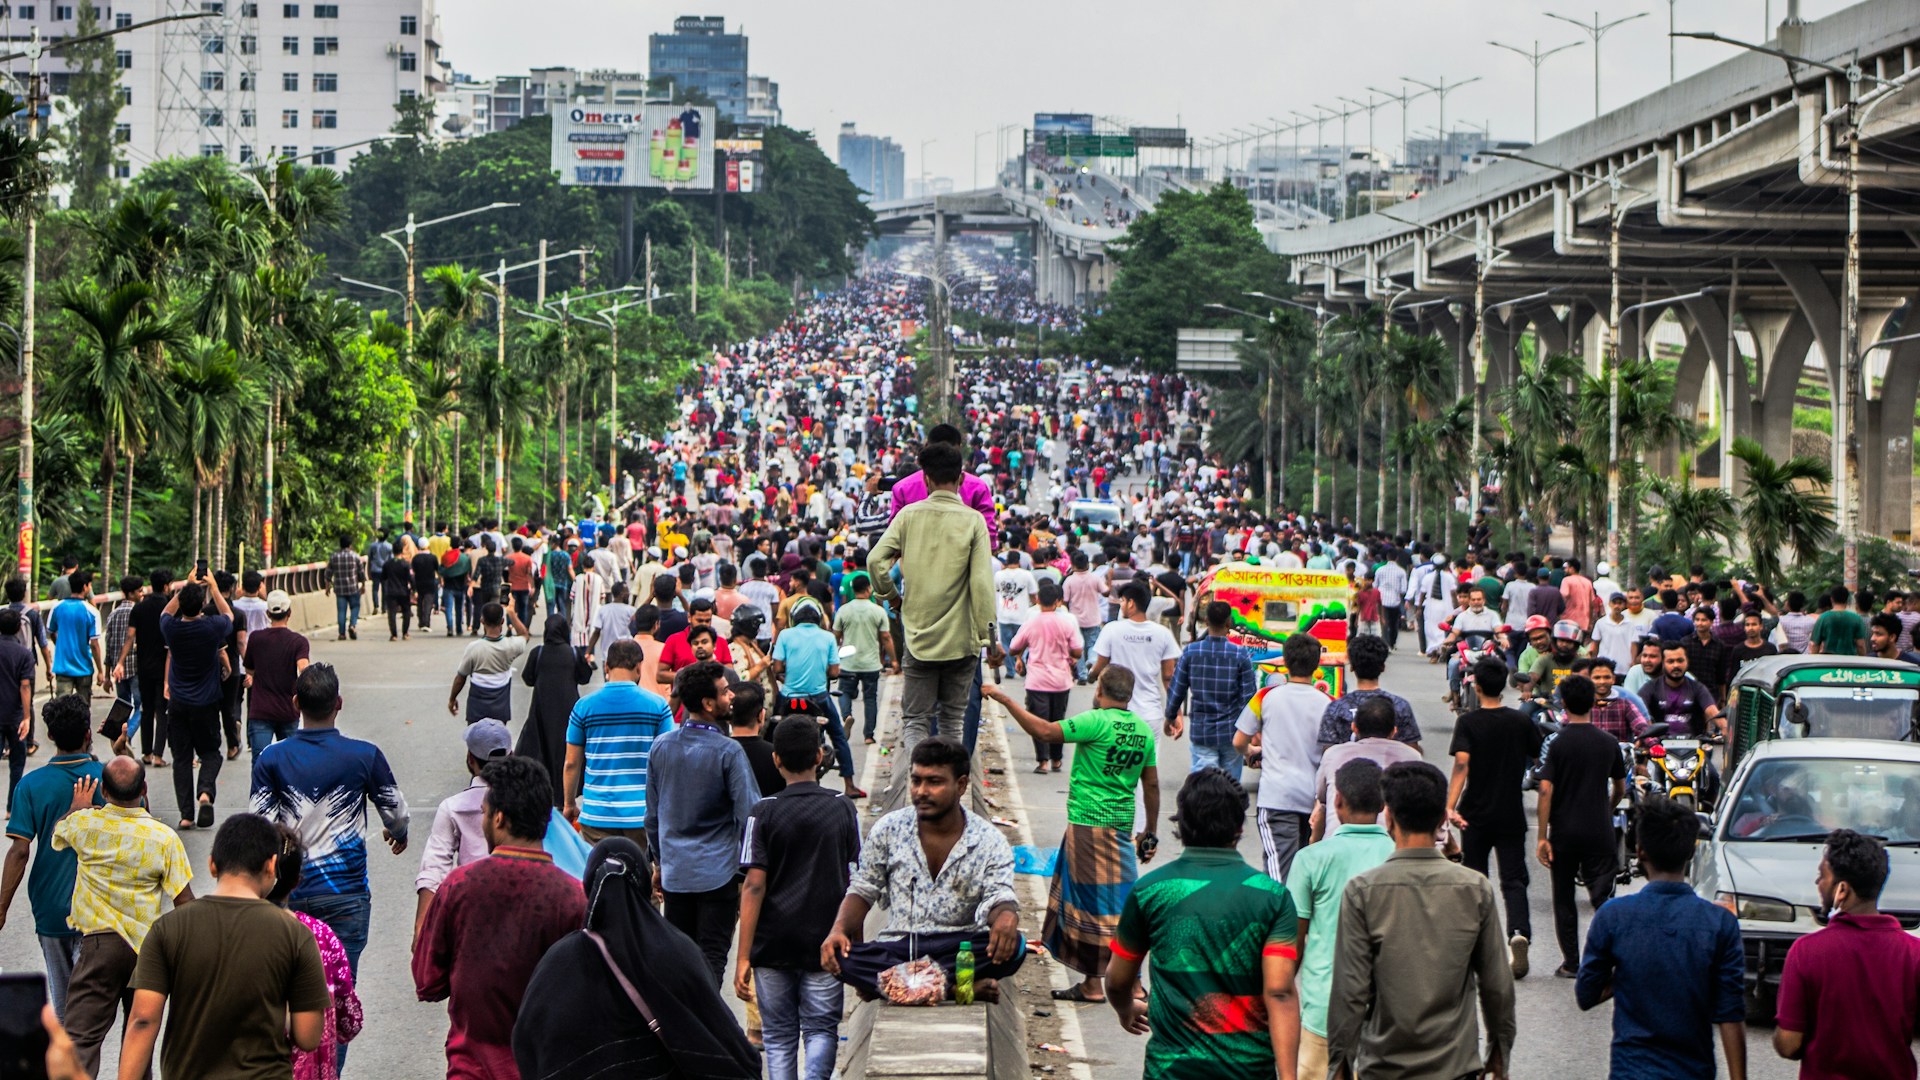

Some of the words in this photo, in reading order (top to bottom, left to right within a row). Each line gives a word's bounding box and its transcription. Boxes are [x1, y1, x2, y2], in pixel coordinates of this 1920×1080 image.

[601, 73, 645, 82] CONCORD
[570, 109, 632, 123] Omera
[1106, 745, 1144, 769] tap
